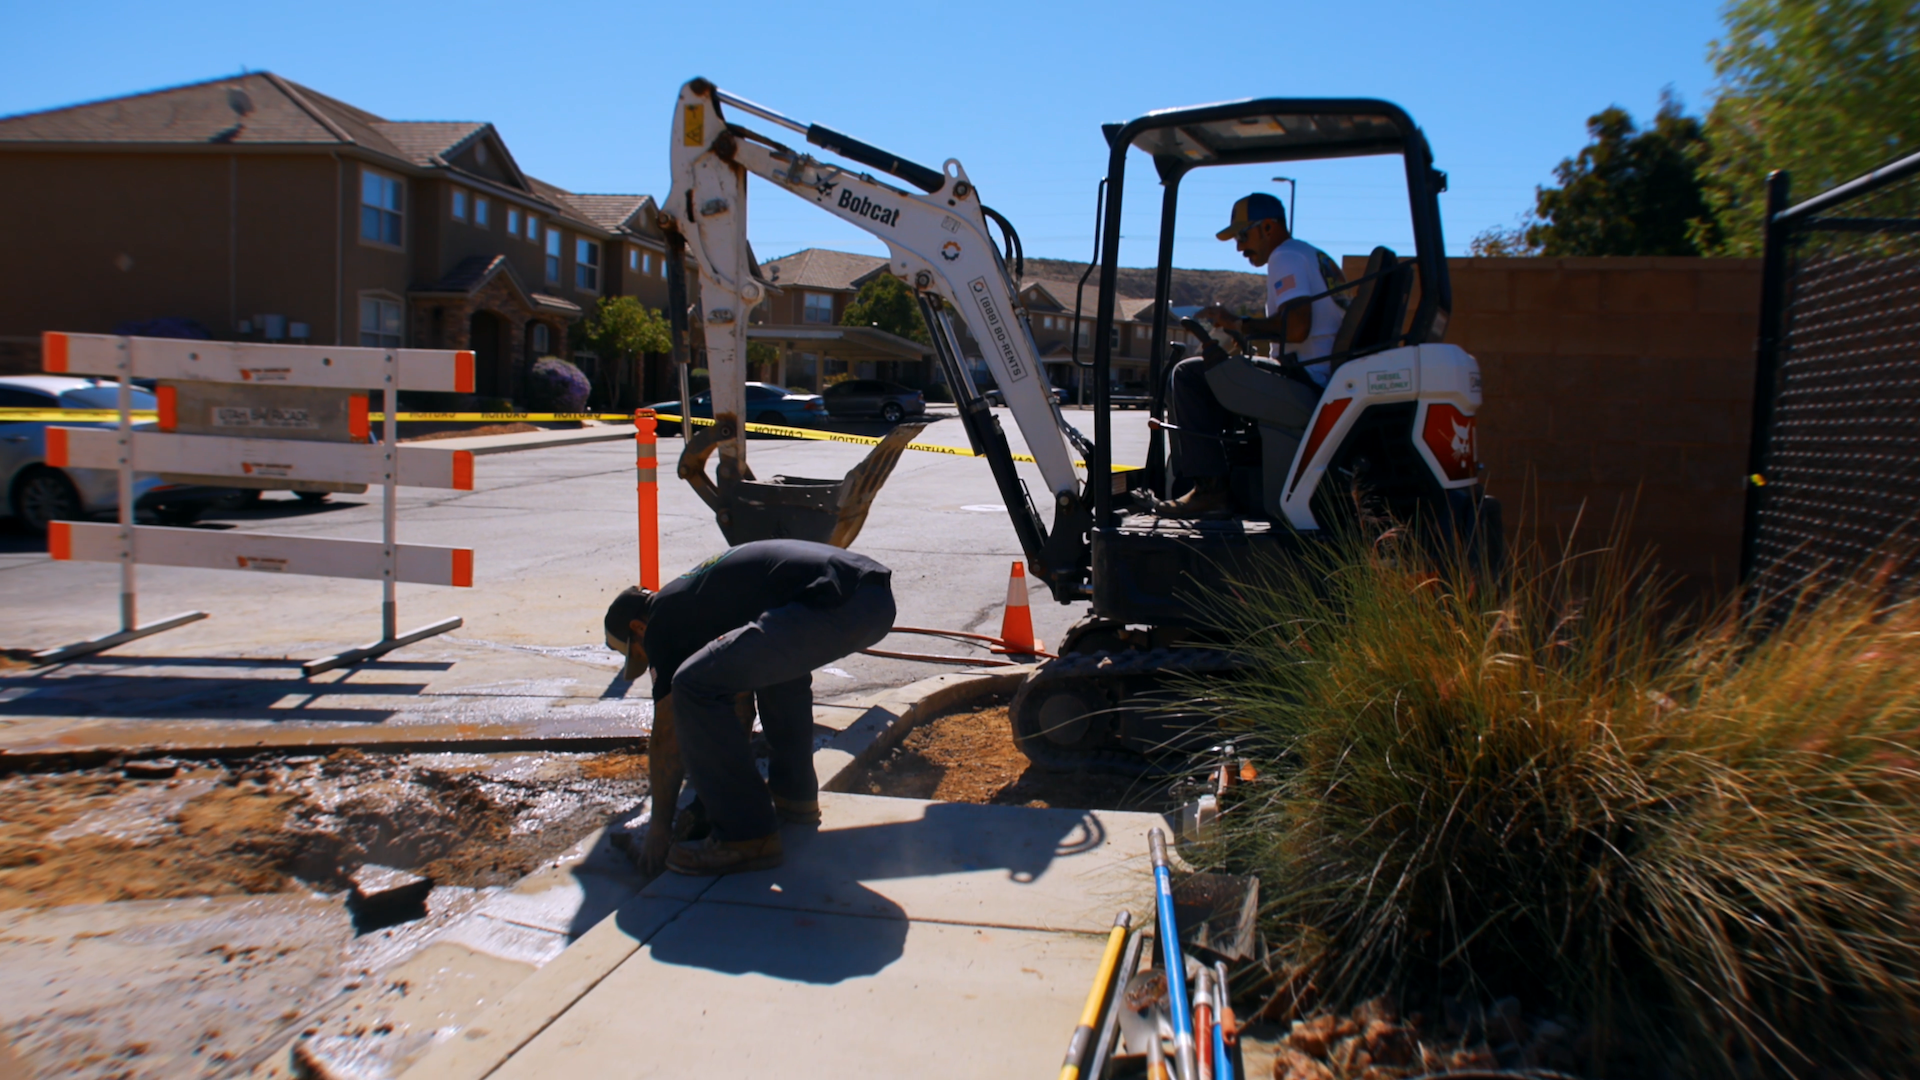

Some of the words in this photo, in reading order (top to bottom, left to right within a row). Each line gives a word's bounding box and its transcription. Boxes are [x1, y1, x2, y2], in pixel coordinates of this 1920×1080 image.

[838, 188, 900, 227] Bobcat
[980, 296, 999, 326] (888)
[1376, 372, 1402, 381] DIESEL
